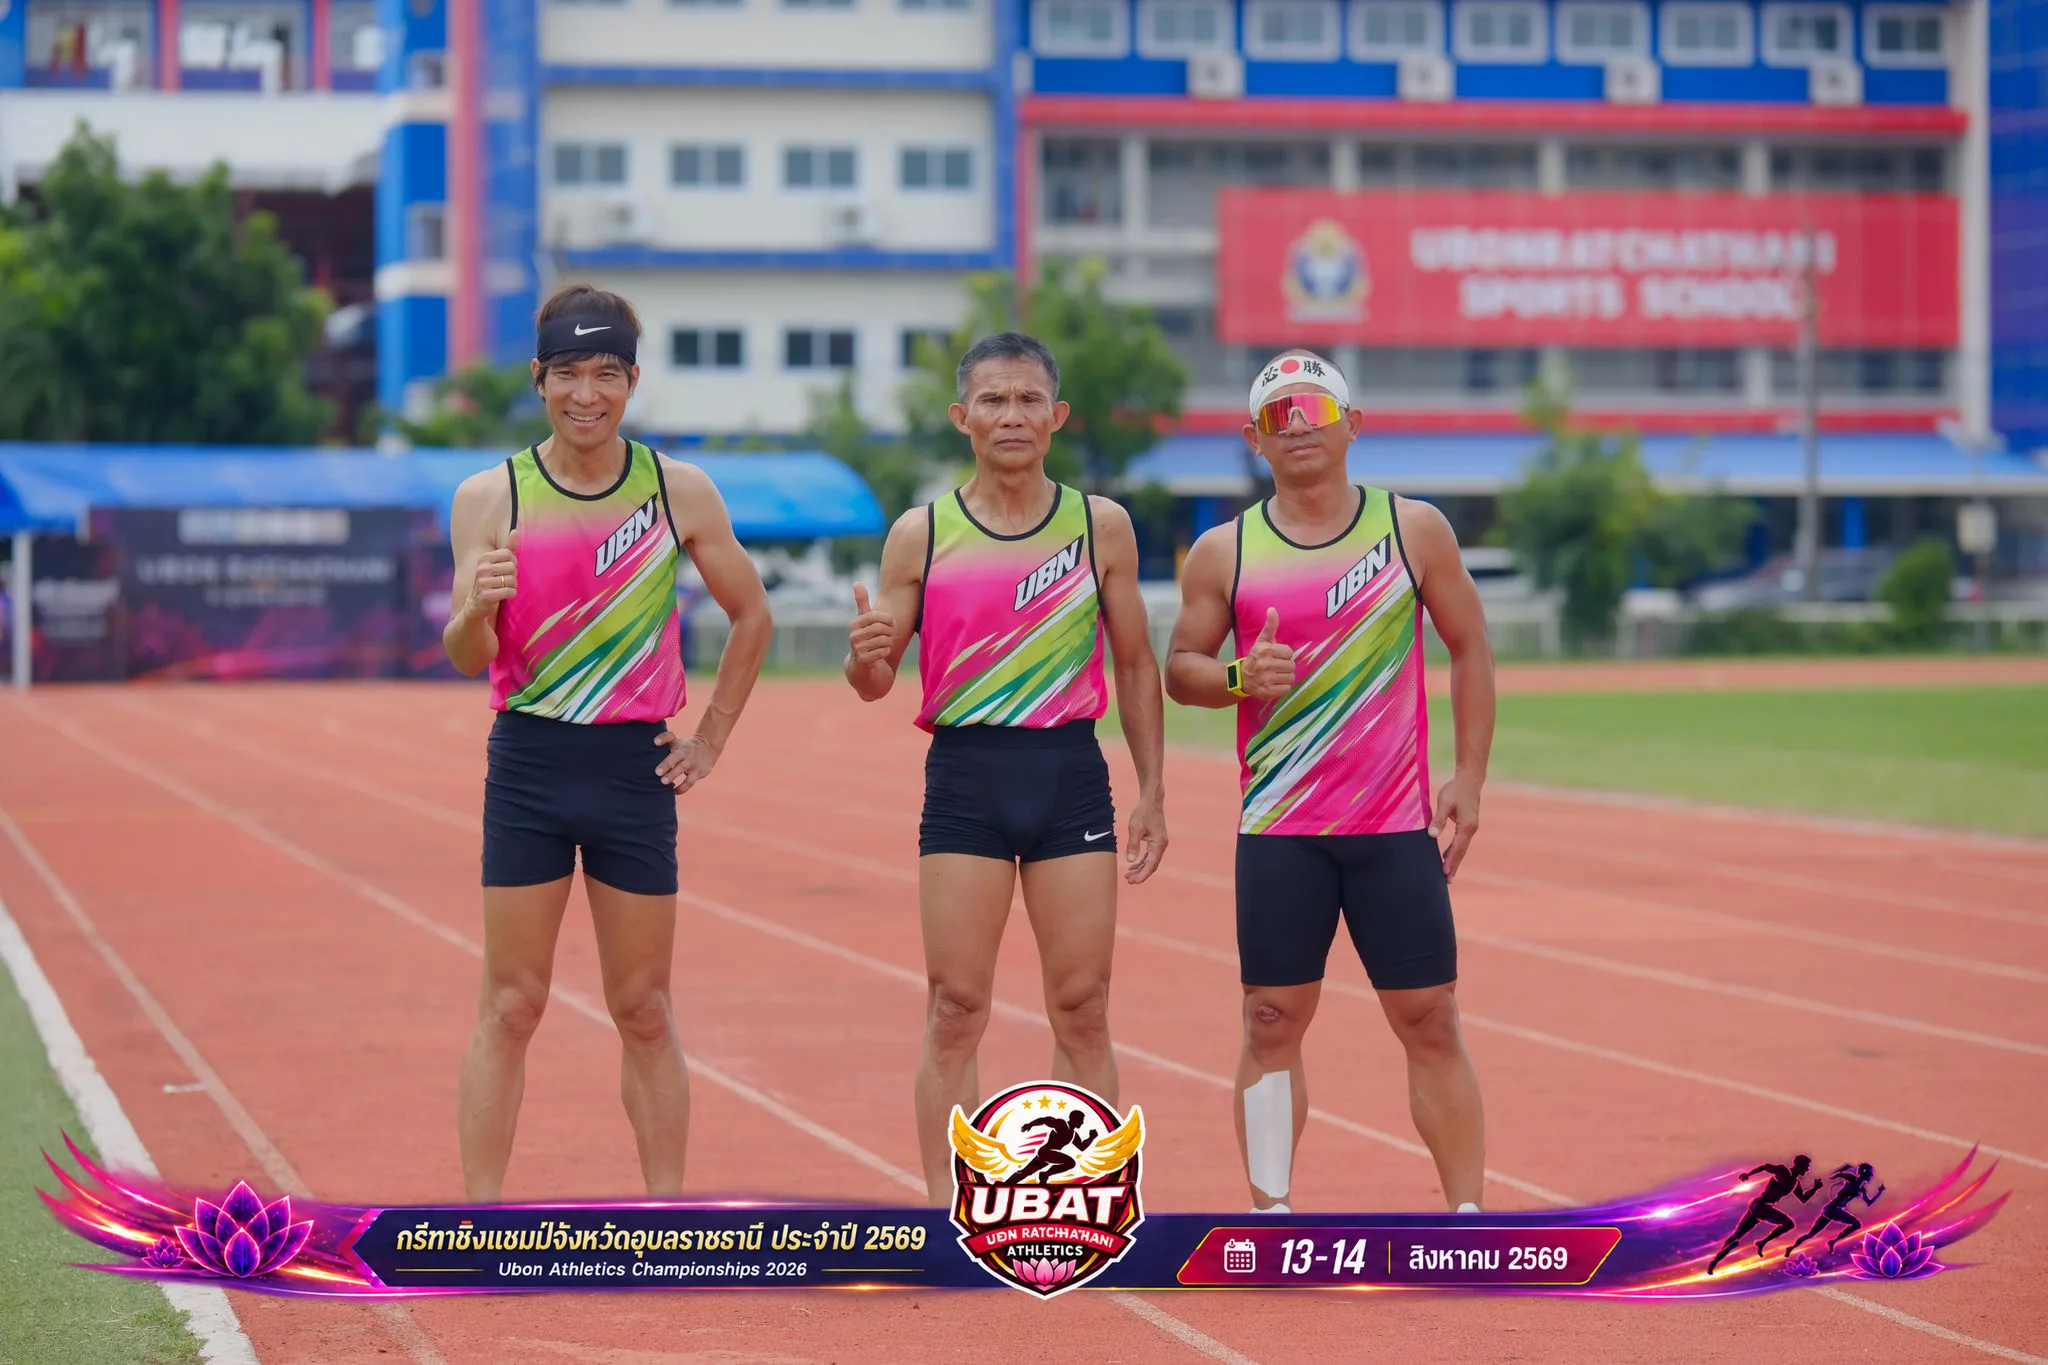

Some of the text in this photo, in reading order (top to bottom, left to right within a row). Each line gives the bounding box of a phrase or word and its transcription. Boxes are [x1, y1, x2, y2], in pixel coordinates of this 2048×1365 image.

[1459, 275, 1808, 320] SPORTS SCHOOL
[595, 494, 657, 577] UBN
[1013, 535, 1083, 612] UBN
[1326, 534, 1391, 618] UBN
